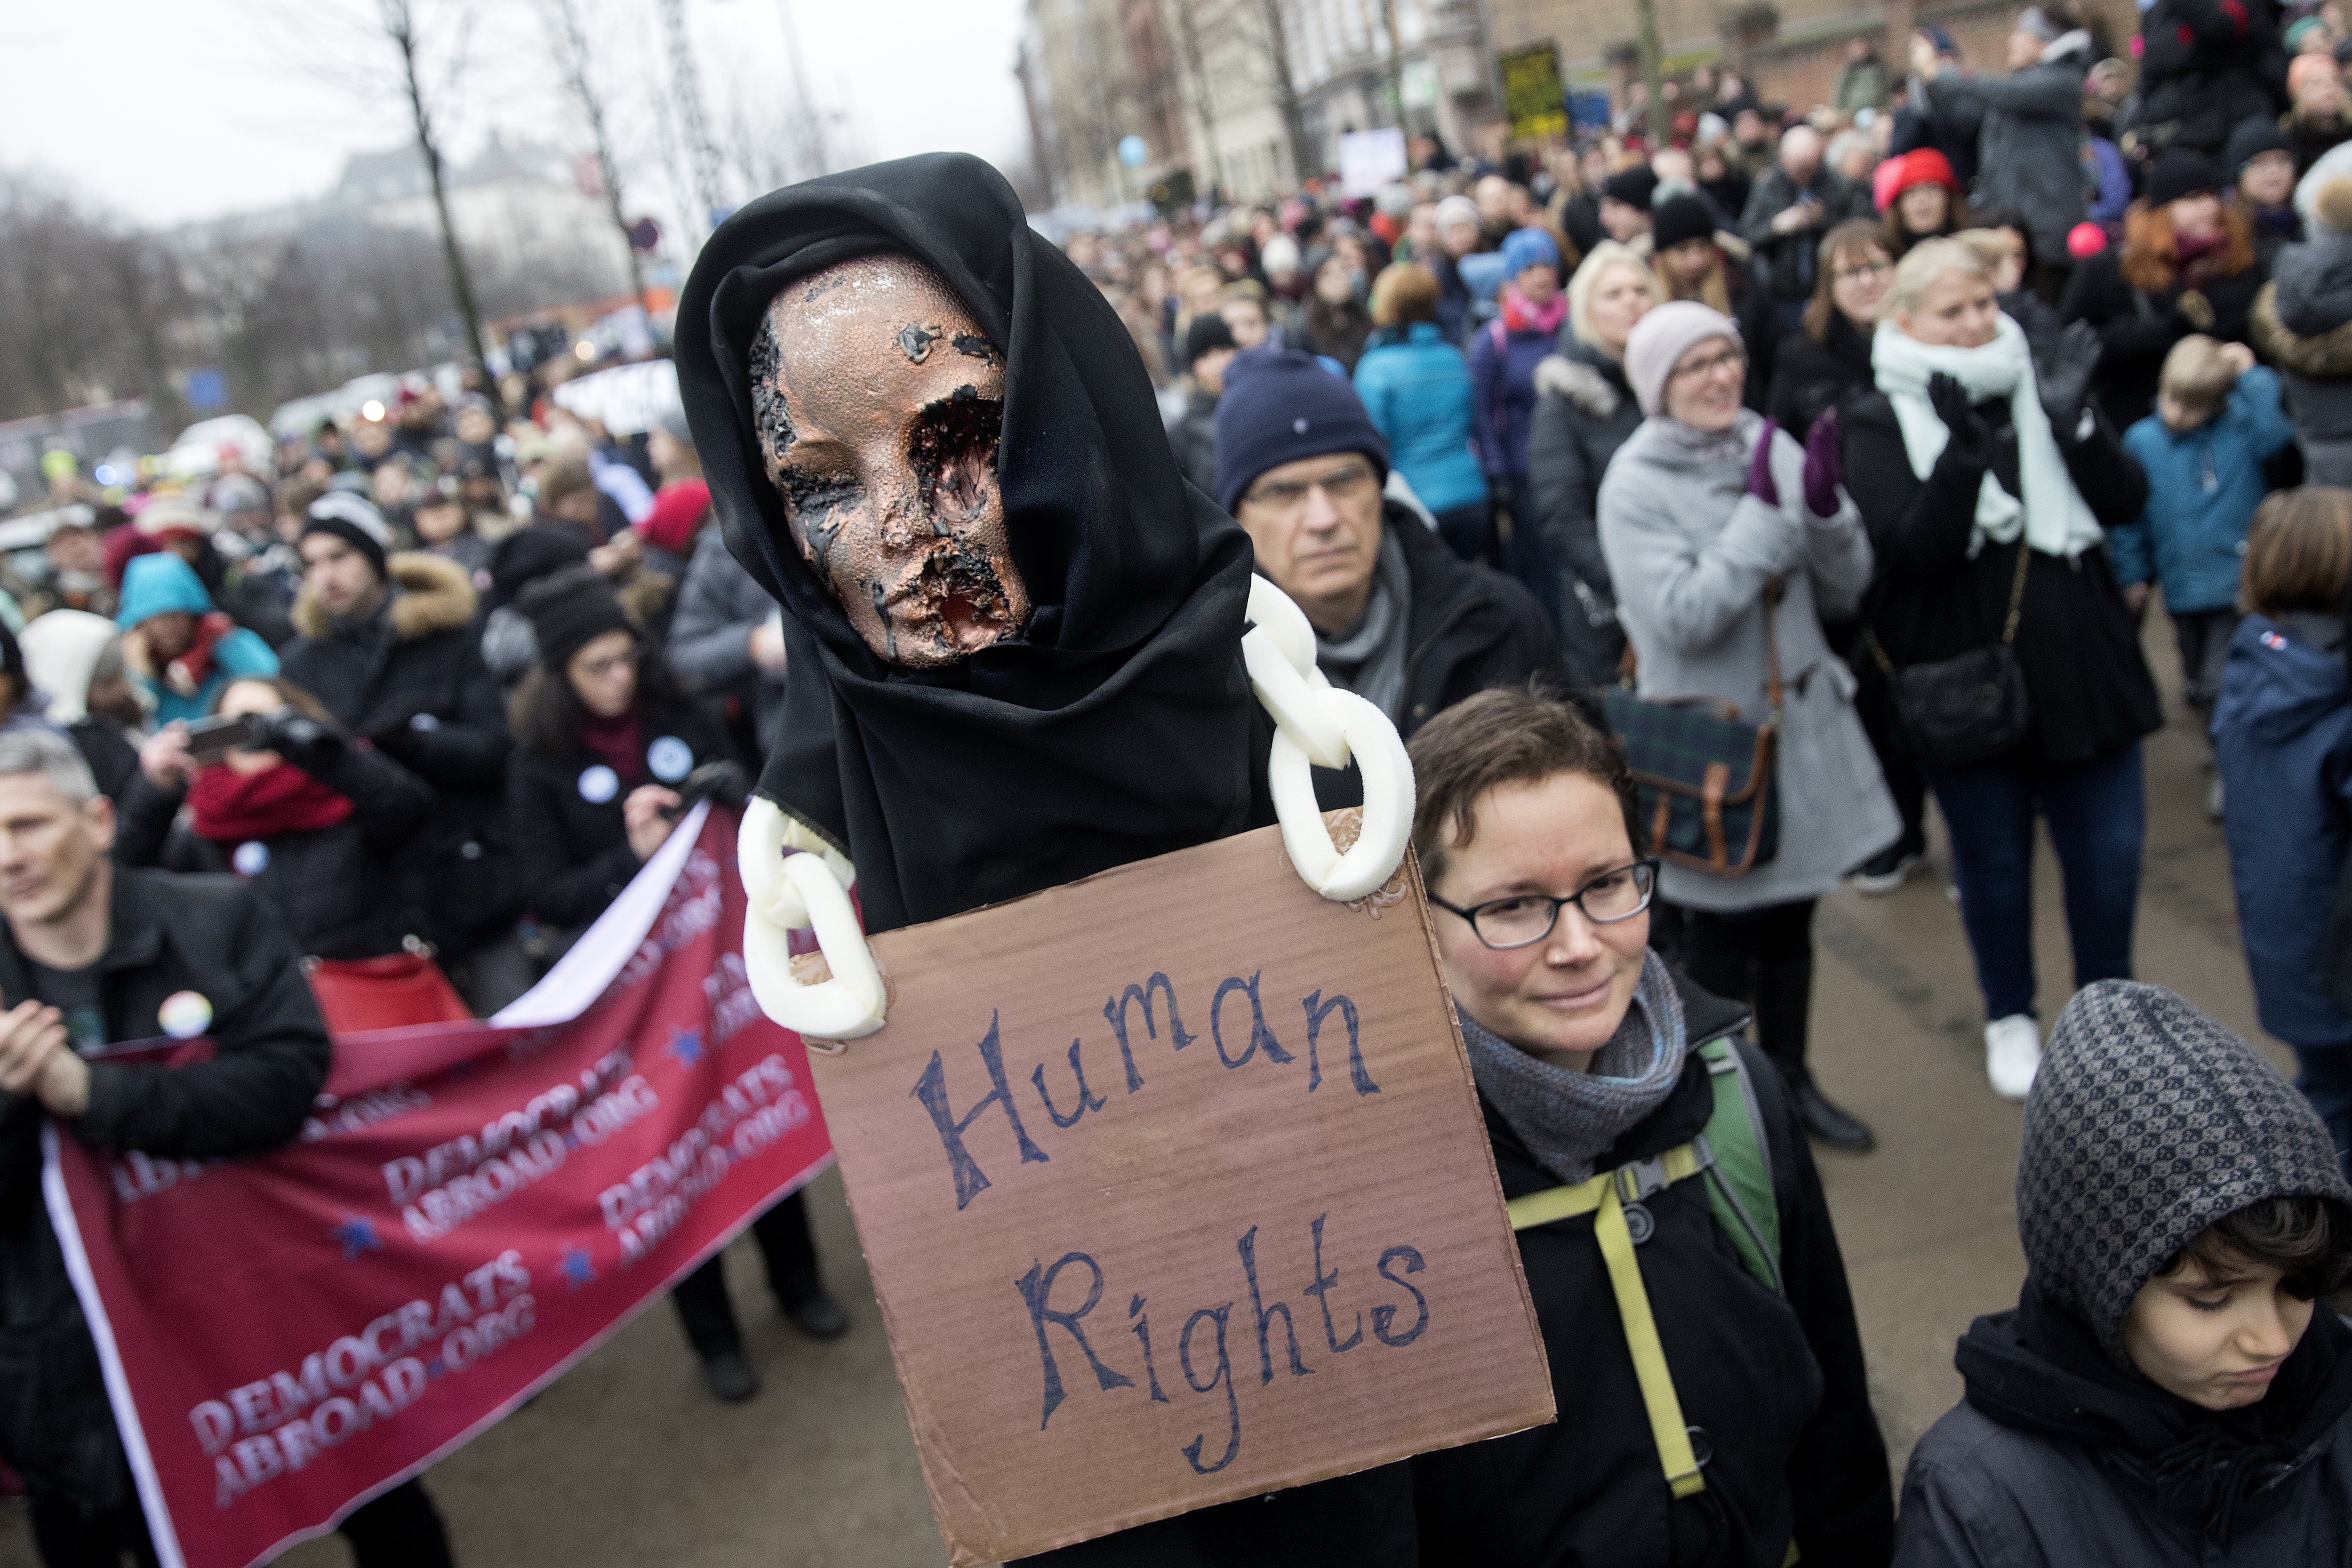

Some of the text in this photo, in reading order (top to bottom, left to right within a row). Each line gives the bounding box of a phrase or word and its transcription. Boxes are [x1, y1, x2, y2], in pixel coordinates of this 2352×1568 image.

[909, 969, 1381, 1211] Human
[188, 1249, 531, 1458] DEMOCRATS
[214, 1355, 427, 1511] ABROAD
[1014, 1213, 1429, 1474] Rights
